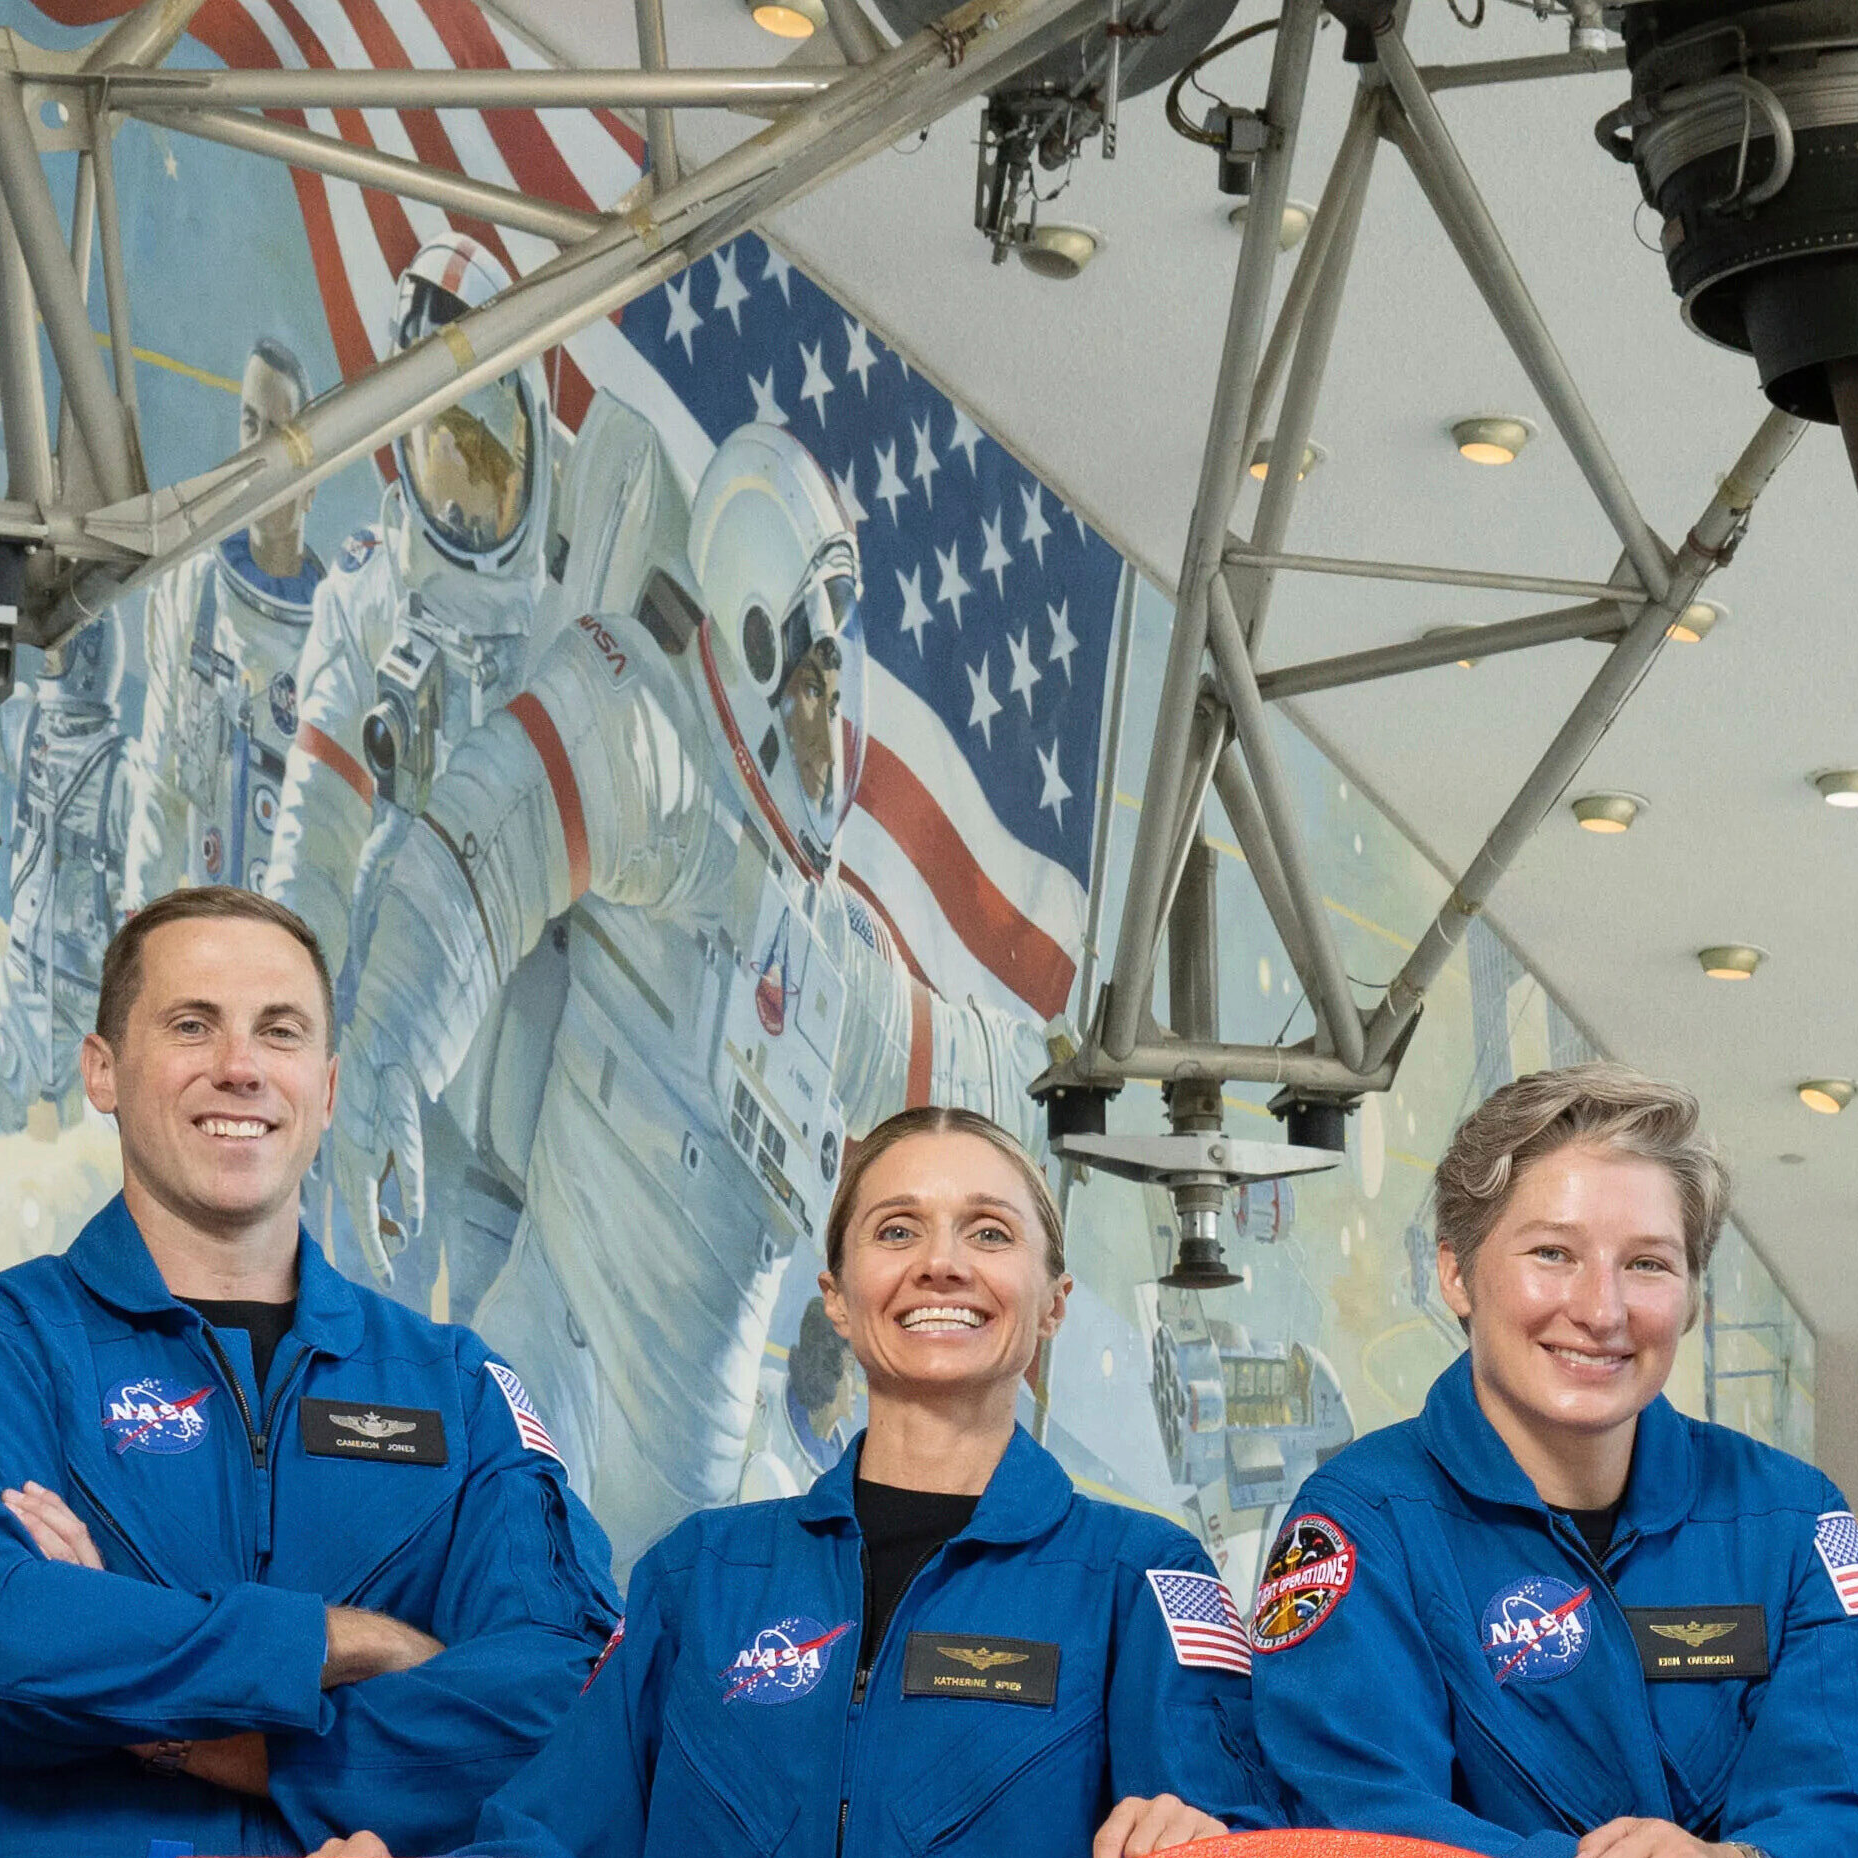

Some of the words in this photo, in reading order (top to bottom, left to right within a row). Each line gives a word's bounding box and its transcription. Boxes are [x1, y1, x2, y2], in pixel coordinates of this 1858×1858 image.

[110, 1402, 205, 1423] NASA
[336, 1438, 381, 1450] CAMERON
[387, 1442, 416, 1453] JONES
[1279, 1553, 1349, 1593] OPERATIONS
[1490, 1611, 1585, 1646] NASA
[734, 1648, 821, 1669] NASA
[1658, 1656, 1681, 1667] ERIN
[1687, 1654, 1734, 1666] OVERCASH
[933, 1676, 987, 1689] KATHERINE
[995, 1679, 1022, 1691] SPIES
